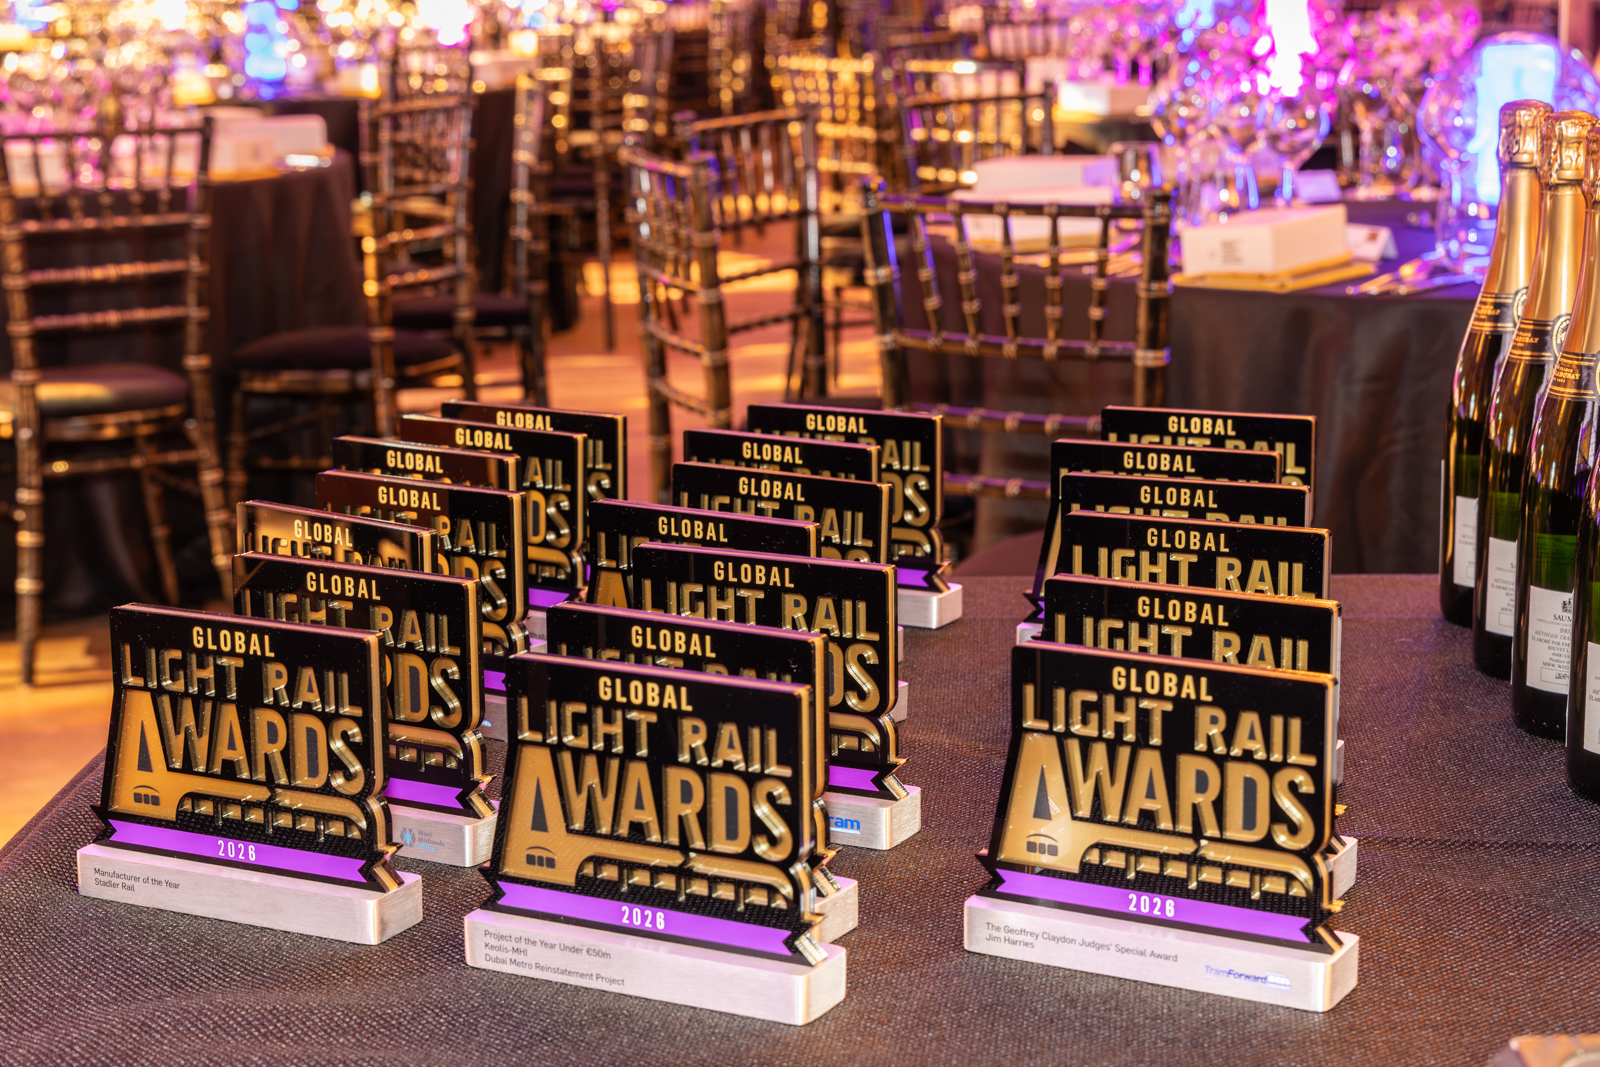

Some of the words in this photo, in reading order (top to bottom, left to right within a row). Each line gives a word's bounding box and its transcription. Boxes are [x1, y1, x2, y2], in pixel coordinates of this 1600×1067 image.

[496, 411, 554, 431] GLOBAL
[806, 413, 868, 434] GLOBAL
[1168, 415, 1236, 436] GLOBAL
[455, 428, 513, 450] GLOBAL
[386, 450, 444, 474] GLOBAL
[742, 441, 803, 465] GLOBAL
[1123, 451, 1196, 473] GLOBAL
[521, 455, 571, 492] AIL
[378, 486, 441, 511] GLOBAL
[738, 476, 805, 502] GLOBAL
[1140, 485, 1218, 509] GLOBAL
[294, 519, 353, 548] GLOBAL
[658, 516, 728, 543] GLOBAL
[1147, 528, 1229, 552] GLOBAL
[713, 560, 795, 588] GLOBAL
[1072, 544, 1198, 587] LIGHT
[1215, 556, 1316, 598] RAIL
[306, 571, 381, 600] GLOBAL
[641, 578, 765, 625] LIGHT
[782, 592, 880, 642] RAIL
[1137, 596, 1229, 627] GLOBAL
[192, 626, 275, 658] GLOBAL
[369, 604, 461, 656] RAIL
[631, 625, 716, 658] GLOBAL
[121, 642, 244, 700] LIGHT
[262, 661, 363, 717] RAIL
[1112, 666, 1213, 702] GLOBAL
[599, 676, 693, 712] GLOBAL
[516, 694, 658, 757] LIGHT
[677, 716, 793, 778] RAIL
[1022, 682, 1174, 746] LIGHT
[1194, 705, 1317, 766] RAIL
[111, 688, 365, 796] AWARDS
[503, 743, 794, 863] AWARDS
[1001, 730, 1316, 851] AWARDS
[217, 839, 256, 862] 2026
[417, 836, 445, 847] Midlands
[417, 842, 436, 852] Metro
[94, 867, 141, 883] Manufacturer
[142, 876, 150, 884] of
[151, 878, 163, 887] the
[164, 879, 180, 889] Year
[94, 877, 120, 889] Stadler
[121, 882, 135, 892] Rail
[621, 905, 665, 930] 2026
[1128, 893, 1175, 918] 2026
[484, 929, 513, 943] Project
[514, 936, 522, 944] of
[524, 937, 537, 946] the
[539, 939, 557, 950] Year
[559, 943, 583, 954] Under
[586, 947, 611, 959] €50m
[484, 942, 528, 957] Keolis-MHI
[985, 933, 1002, 943] Jim
[1003, 936, 1035, 949] Harries
[985, 921, 1002, 932] The
[1003, 925, 1040, 940] Geoffrey
[1041, 931, 1077, 945] Claydon
[1078, 938, 1112, 951] Judges'
[1114, 944, 1147, 957] Special
[1149, 950, 1178, 962] Award
[484, 953, 508, 965] Dubai
[509, 958, 533, 970] Metro
[535, 962, 594, 981] Reinstatement
[595, 973, 625, 986] Project
[1204, 965, 1268, 984] TramForward
